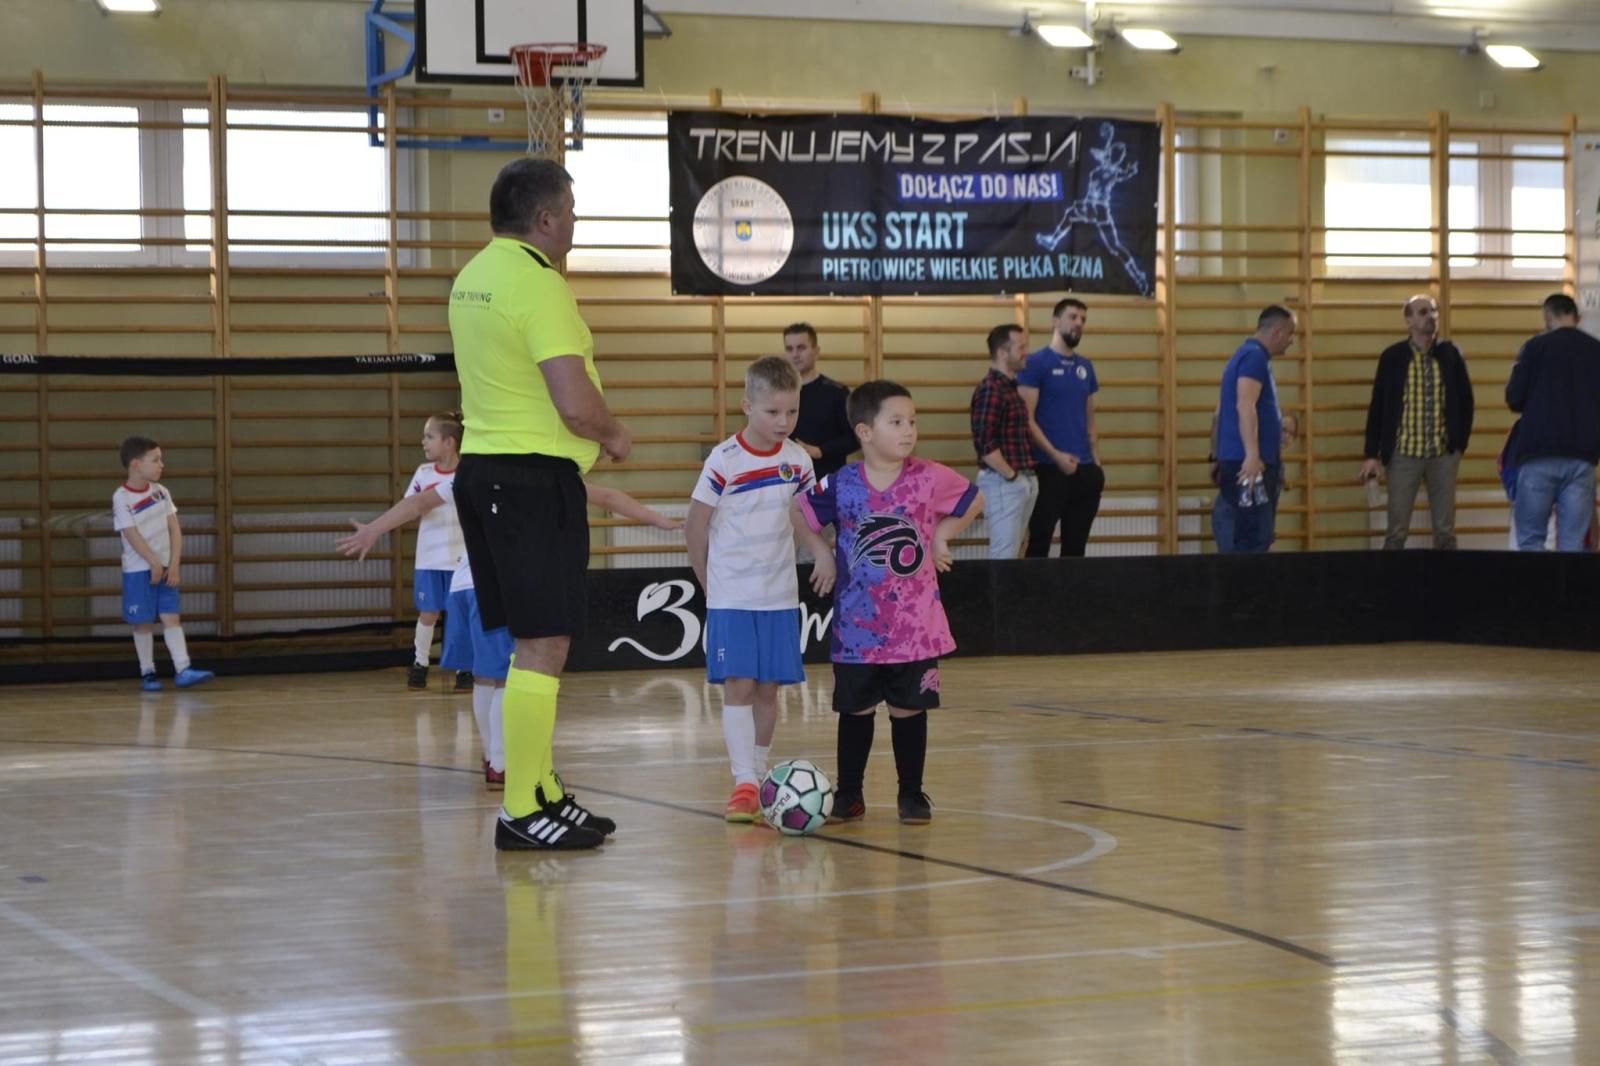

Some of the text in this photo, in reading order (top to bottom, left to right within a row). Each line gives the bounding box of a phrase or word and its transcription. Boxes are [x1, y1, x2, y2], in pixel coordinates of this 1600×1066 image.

[690, 127, 914, 163] TRENUJEMY
[922, 134, 946, 164] Z
[901, 173, 1058, 203] DOŁĄCZ DO NAS!
[822, 211, 968, 250] UKS START
[822, 257, 926, 282] PIETROWICE
[930, 256, 999, 281] WIELKIE
[1003, 254, 1055, 280] PIŁKA
[3, 352, 38, 364] GOAL
